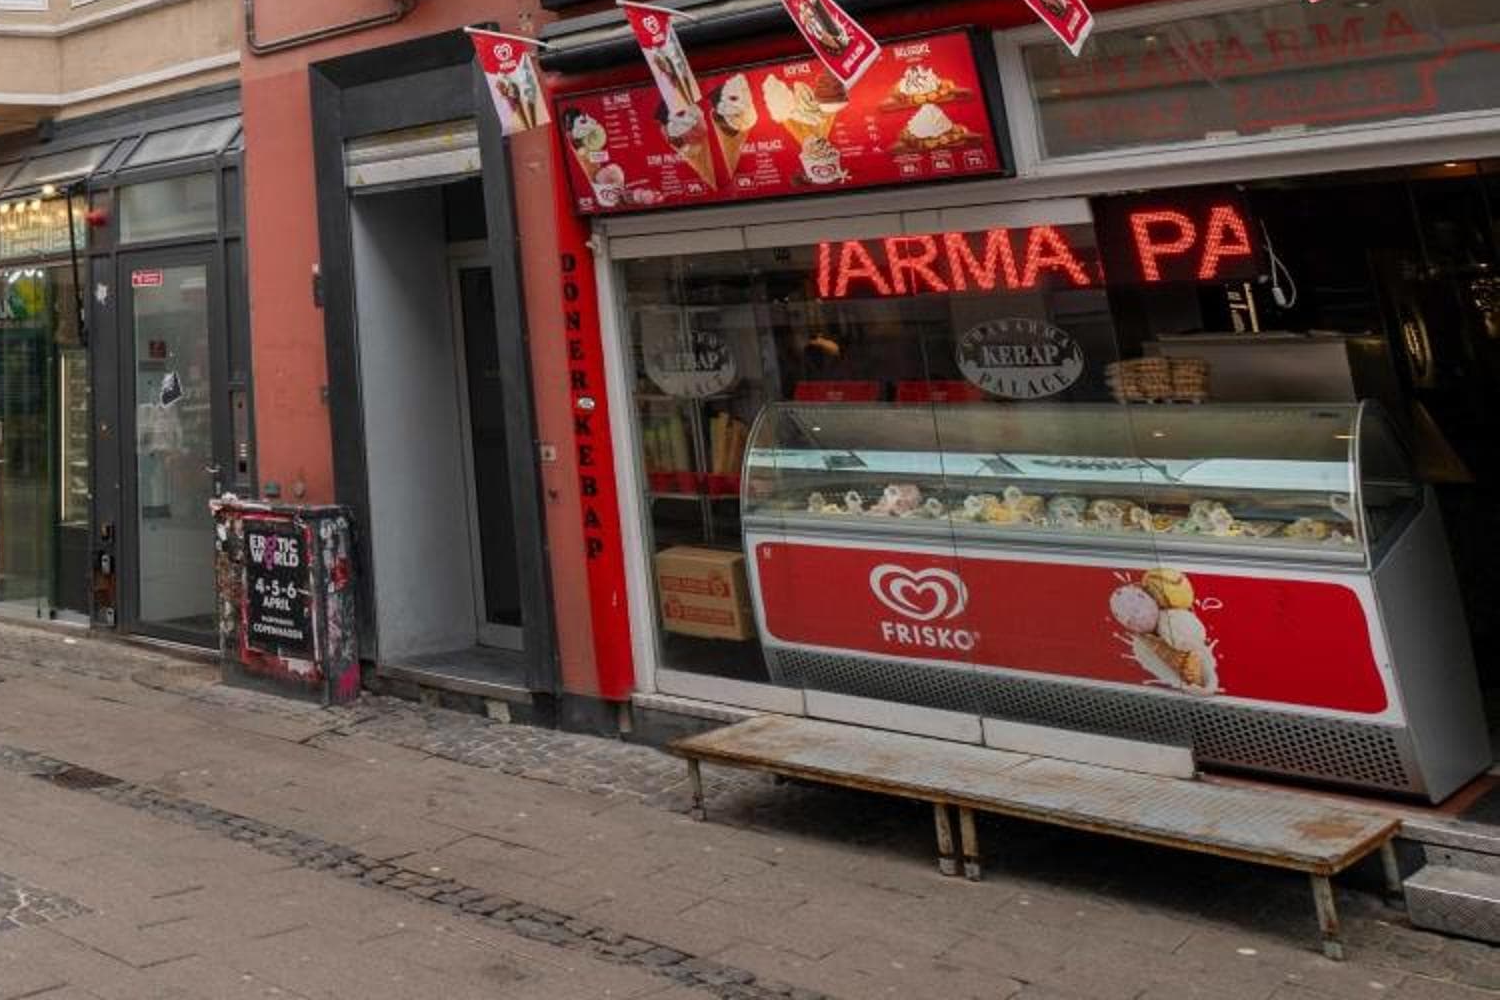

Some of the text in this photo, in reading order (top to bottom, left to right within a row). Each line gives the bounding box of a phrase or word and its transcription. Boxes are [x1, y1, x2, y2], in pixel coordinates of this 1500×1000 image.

[816, 223, 1092, 297] ARMA
[981, 344, 1060, 367] KEBAP
[574, 413, 604, 560] KEBAP
[249, 534, 299, 553] EROTIC
[251, 548, 299, 568] WORLD
[262, 596, 292, 611] APRIL
[881, 621, 975, 651] FRISKO
